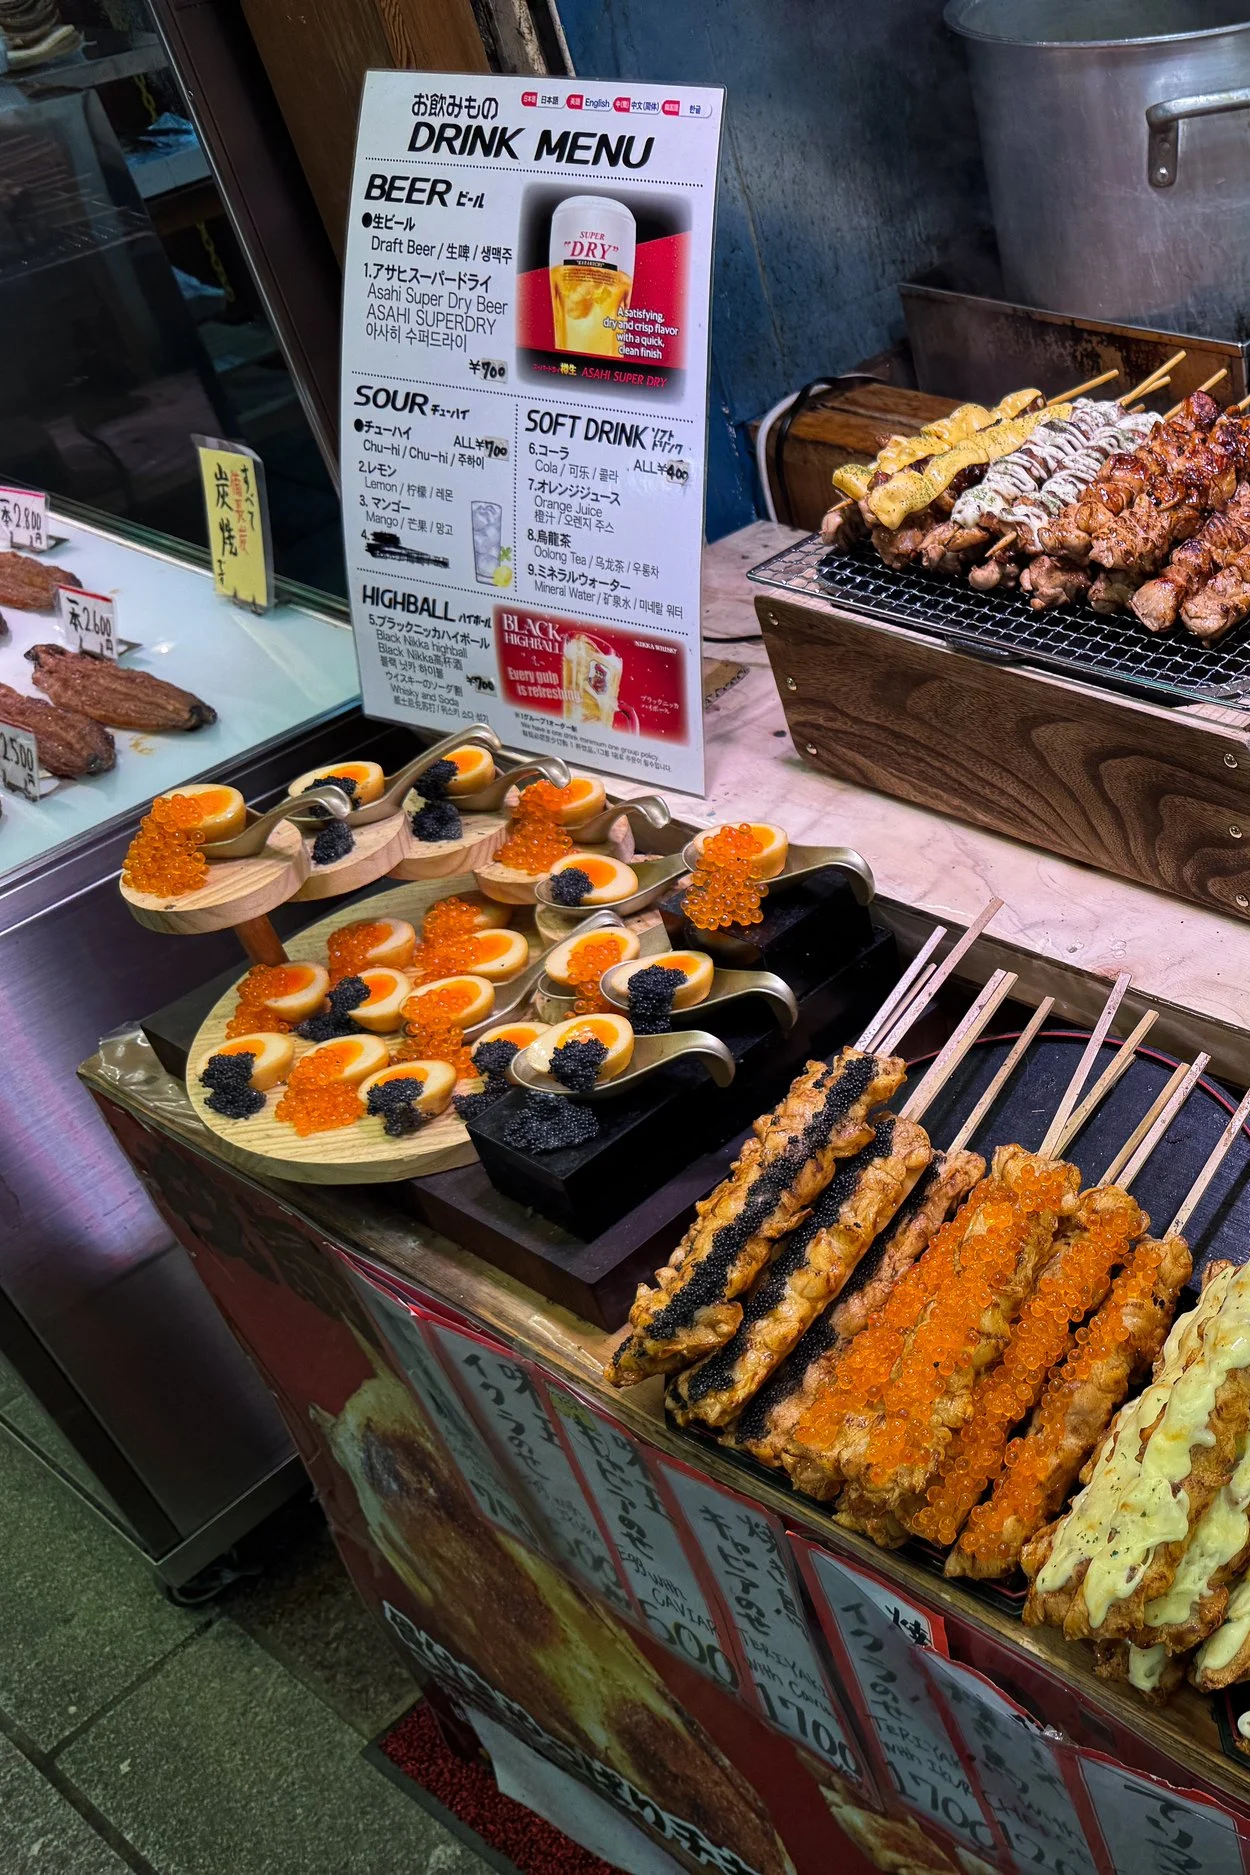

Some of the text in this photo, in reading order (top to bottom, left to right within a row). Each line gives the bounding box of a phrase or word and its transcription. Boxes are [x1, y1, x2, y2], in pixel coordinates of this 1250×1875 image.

[411, 93, 499, 120] お飲みもの
[540, 95, 560, 105] 日本語
[585, 98, 610, 109] English
[407, 121, 655, 169] DRINK MENU
[364, 173, 485, 209] BEER ビール
[579, 231, 605, 241] SUPER
[371, 235, 513, 265] Draft Beer 生啤 생맥주
[367, 282, 509, 315] Asahi Super Dry Beer
[366, 303, 496, 336] ASAHI SUPERDRY
[617, 307, 624, 317] A
[365, 322, 467, 353] 아사히 수퍼드라이
[603, 316, 679, 336] dry and crisp flavor
[616, 333, 665, 347] with a quick,
[618, 346, 662, 359] clean finish
[468, 359, 506, 379] ¥700
[581, 367, 667, 388] ASAHI SUPER DRY
[353, 385, 470, 420] SOUR チューハイ
[524, 409, 650, 451] SOFT DRINK
[652, 427, 675, 441] ソフト
[528, 442, 570, 461] 6.コーラ
[652, 439, 684, 455] ドリンク
[358, 460, 397, 478] 2.レモン
[534, 459, 619, 484] Cola 可乐 콜라
[364, 476, 453, 503] Lemon 柠檬 레몬
[527, 478, 621, 506] 7.オレンジジュース
[359, 495, 411, 514] 3. マンゴー
[534, 495, 603, 518] Orange Juice
[366, 511, 453, 536] Mango 芒果 망고
[534, 509, 556, 526] 橙汁
[595, 519, 615, 534] 주스
[360, 529, 370, 541] 4.
[533, 545, 568, 565] Oolong
[571, 551, 587, 566] Tea
[527, 563, 631, 593] 9.ミネラルウォーター
[534, 580, 567, 598] Mineral
[569, 586, 595, 603] Water
[362, 584, 492, 629] HIGHBALL ハイボール
[502, 613, 563, 642] BLACK
[376, 629, 468, 659] Black Nikka highball
[378, 642, 405, 658] Black
[504, 631, 563, 654] HIGHBALL
[507, 666, 560, 685] Every gulp
[390, 683, 419, 700] Whisky
[421, 692, 437, 702] and
[438, 694, 460, 707] Soda
[516, 682, 528, 696] is
[615, 1543, 648, 1578] Egg
[652, 1588, 722, 1638] CAVIAR
[636, 1598, 740, 1690] 500
[755, 1682, 864, 1778] 1700
[885, 1759, 1000, 1852] 1700
